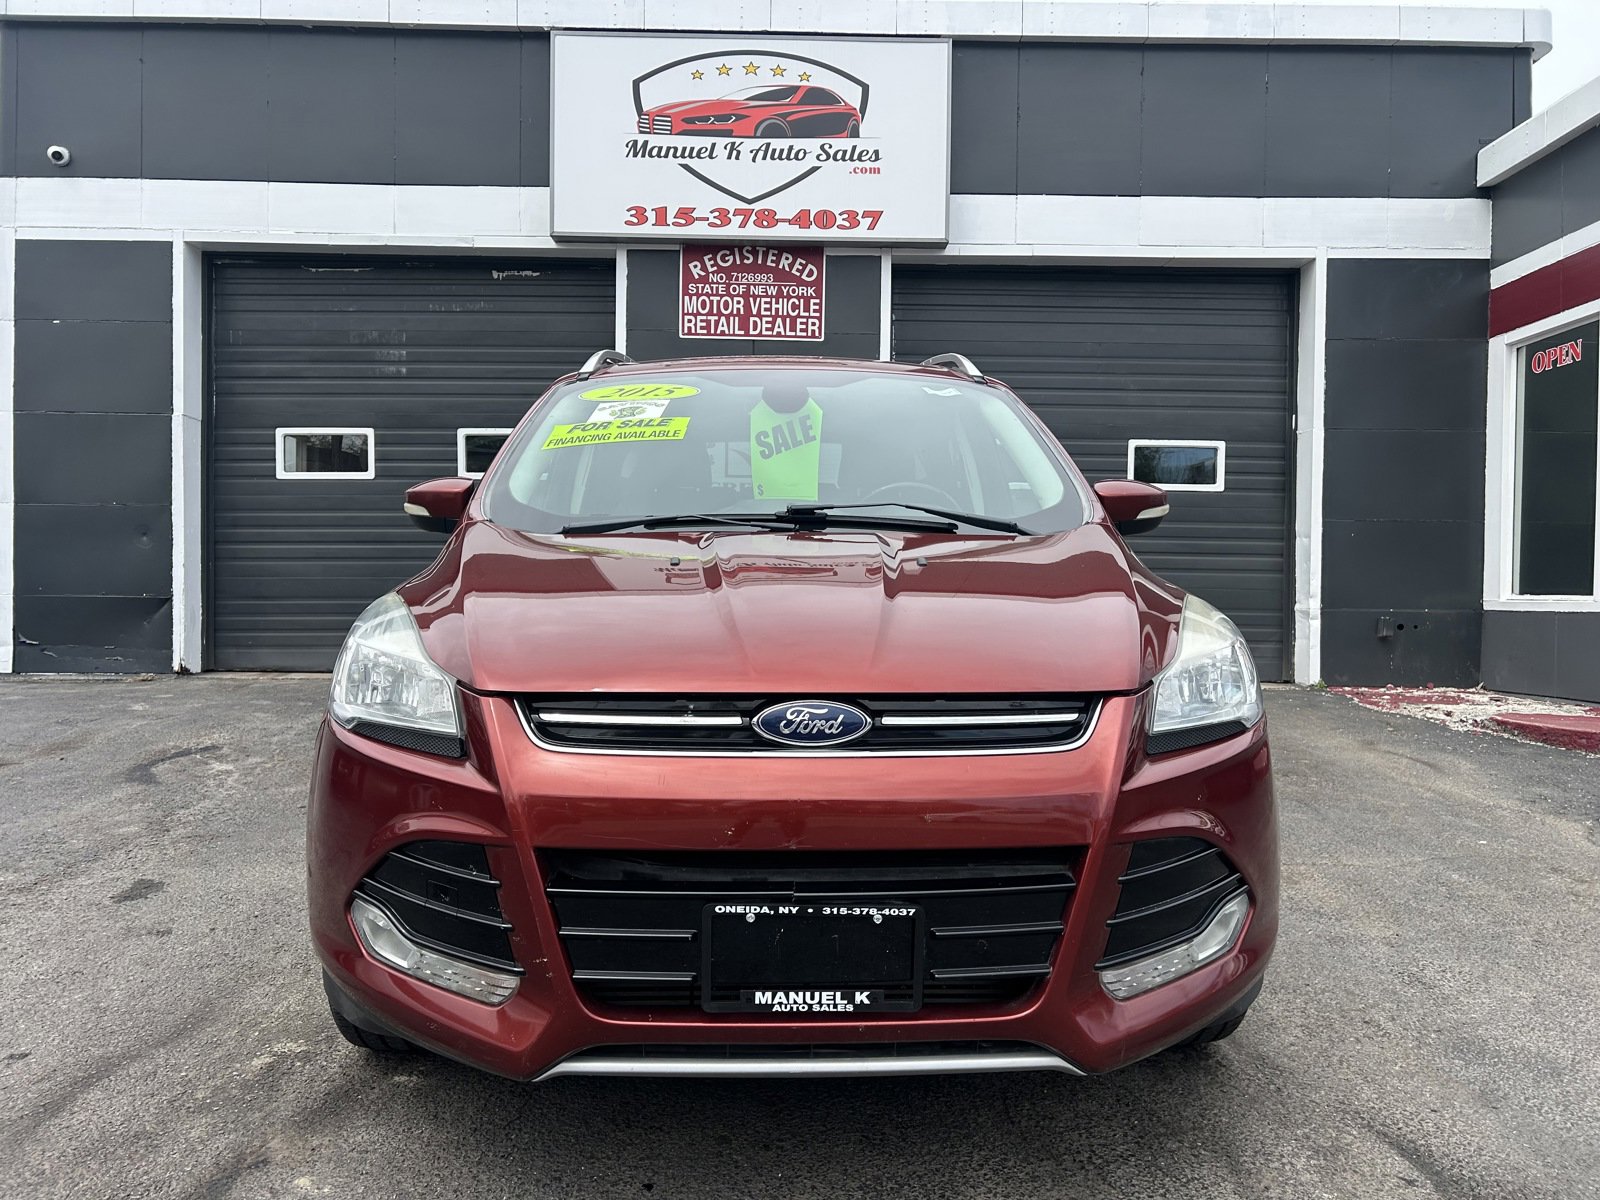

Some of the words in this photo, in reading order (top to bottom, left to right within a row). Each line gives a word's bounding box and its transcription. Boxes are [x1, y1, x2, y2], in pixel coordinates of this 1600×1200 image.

[625, 139, 718, 160] Manuel
[723, 141, 742, 161] K
[750, 142, 812, 163] Auto
[815, 143, 882, 163] Sales
[849, 165, 881, 175] .com
[624, 205, 884, 231] 315-378-4037
[688, 246, 818, 281] REGISTERED
[709, 273, 729, 283] NO.
[731, 272, 774, 283] 7126993
[688, 284, 726, 294] STATE
[730, 284, 747, 295] OF
[750, 285, 778, 296] NEW
[781, 286, 816, 297] YORK
[684, 296, 744, 315] MOTOR
[750, 298, 820, 317] VEHICLE
[684, 315, 745, 334] RETAIL
[749, 317, 820, 337] DEALER
[1531, 339, 1582, 373] OPEN
[598, 387, 685, 399] 2015
[568, 421, 612, 434] FOR
[616, 418, 673, 430] SALE
[547, 433, 612, 447] FINANCING
[614, 430, 681, 440] AVAILABLE
[754, 414, 817, 460] SALE
[757, 483, 764, 497] $
[779, 707, 845, 734] Ford
[715, 905, 775, 915] ONEIDA,
[779, 906, 799, 914] NY
[822, 907, 916, 916] 315-378-4037
[754, 991, 847, 1004] MANUEL
[855, 991, 870, 1004] K
[812, 1004, 854, 1012] SALES
